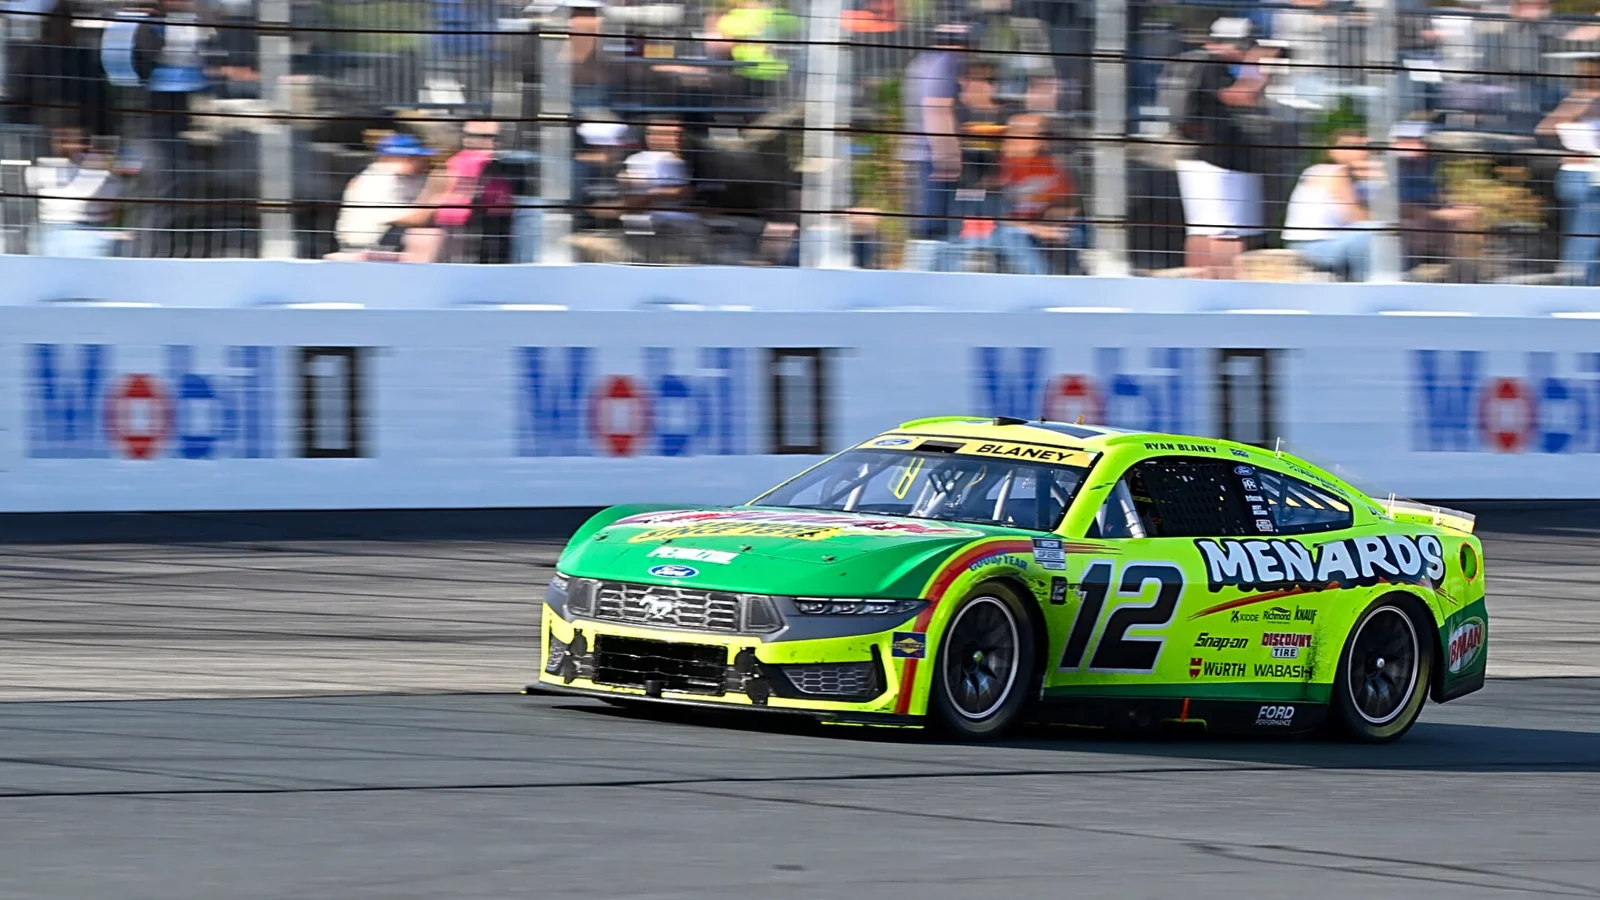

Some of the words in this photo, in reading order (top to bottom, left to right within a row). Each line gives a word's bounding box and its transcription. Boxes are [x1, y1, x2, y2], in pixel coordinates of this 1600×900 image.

[25, 343, 274, 459] Mobil
[513, 346, 745, 457] Mobil
[976, 444, 1074, 462] BLANEY
[1144, 442, 1174, 451] RYAN
[1176, 443, 1217, 453] BLANEY
[1195, 535, 1445, 588] MENARDS
[1060, 560, 1185, 672] 12
[1263, 609, 1291, 621] Richmond
[1194, 632, 1249, 651] Snap-on
[1262, 633, 1312, 647] DISCOUNT
[1273, 648, 1296, 657] TIRE
[1254, 664, 1313, 679] WABASH
[1257, 706, 1295, 719] FORD
